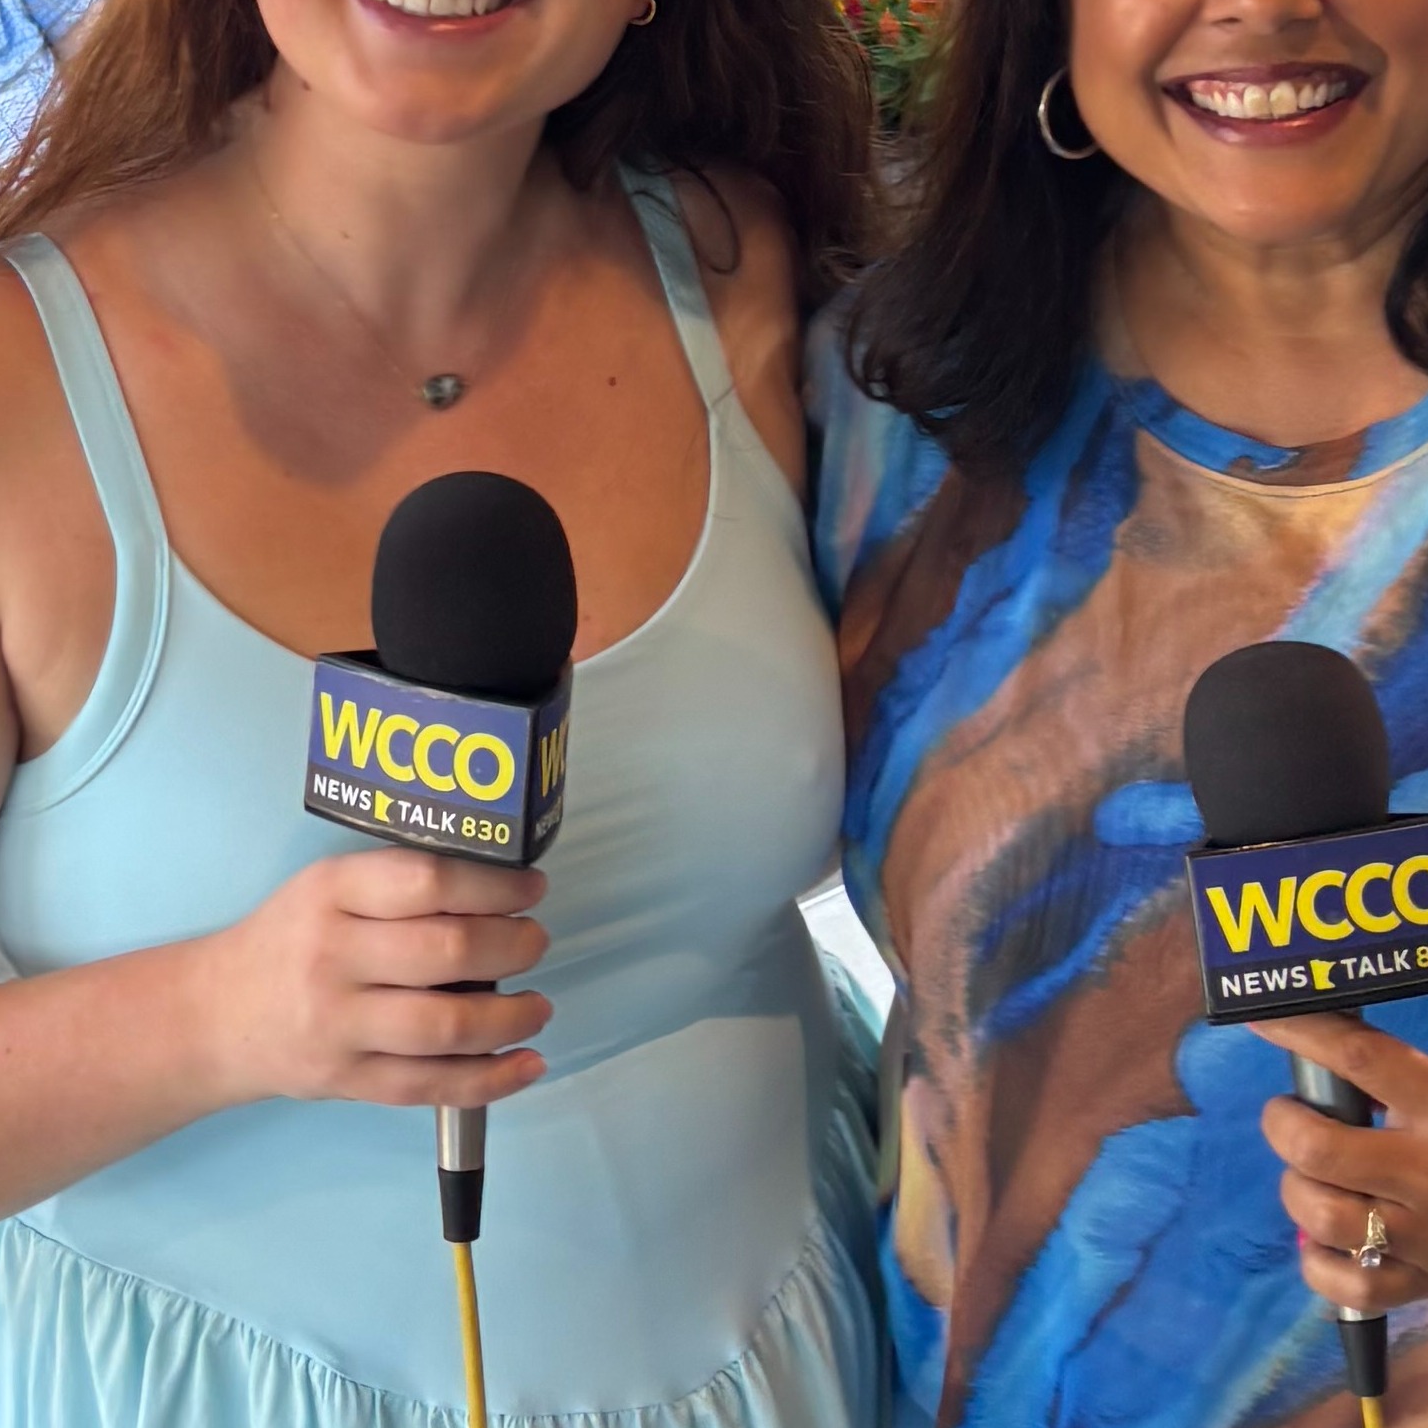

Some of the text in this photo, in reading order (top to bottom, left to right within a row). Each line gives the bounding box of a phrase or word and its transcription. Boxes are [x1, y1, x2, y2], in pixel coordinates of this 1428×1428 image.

[320, 691, 515, 801] WCCO
[313, 772, 372, 811] NEWS
[397, 800, 456, 834] TALK
[461, 816, 510, 845] 830
[1221, 965, 1308, 998] NEWS
[1340, 949, 1412, 981] TALK
